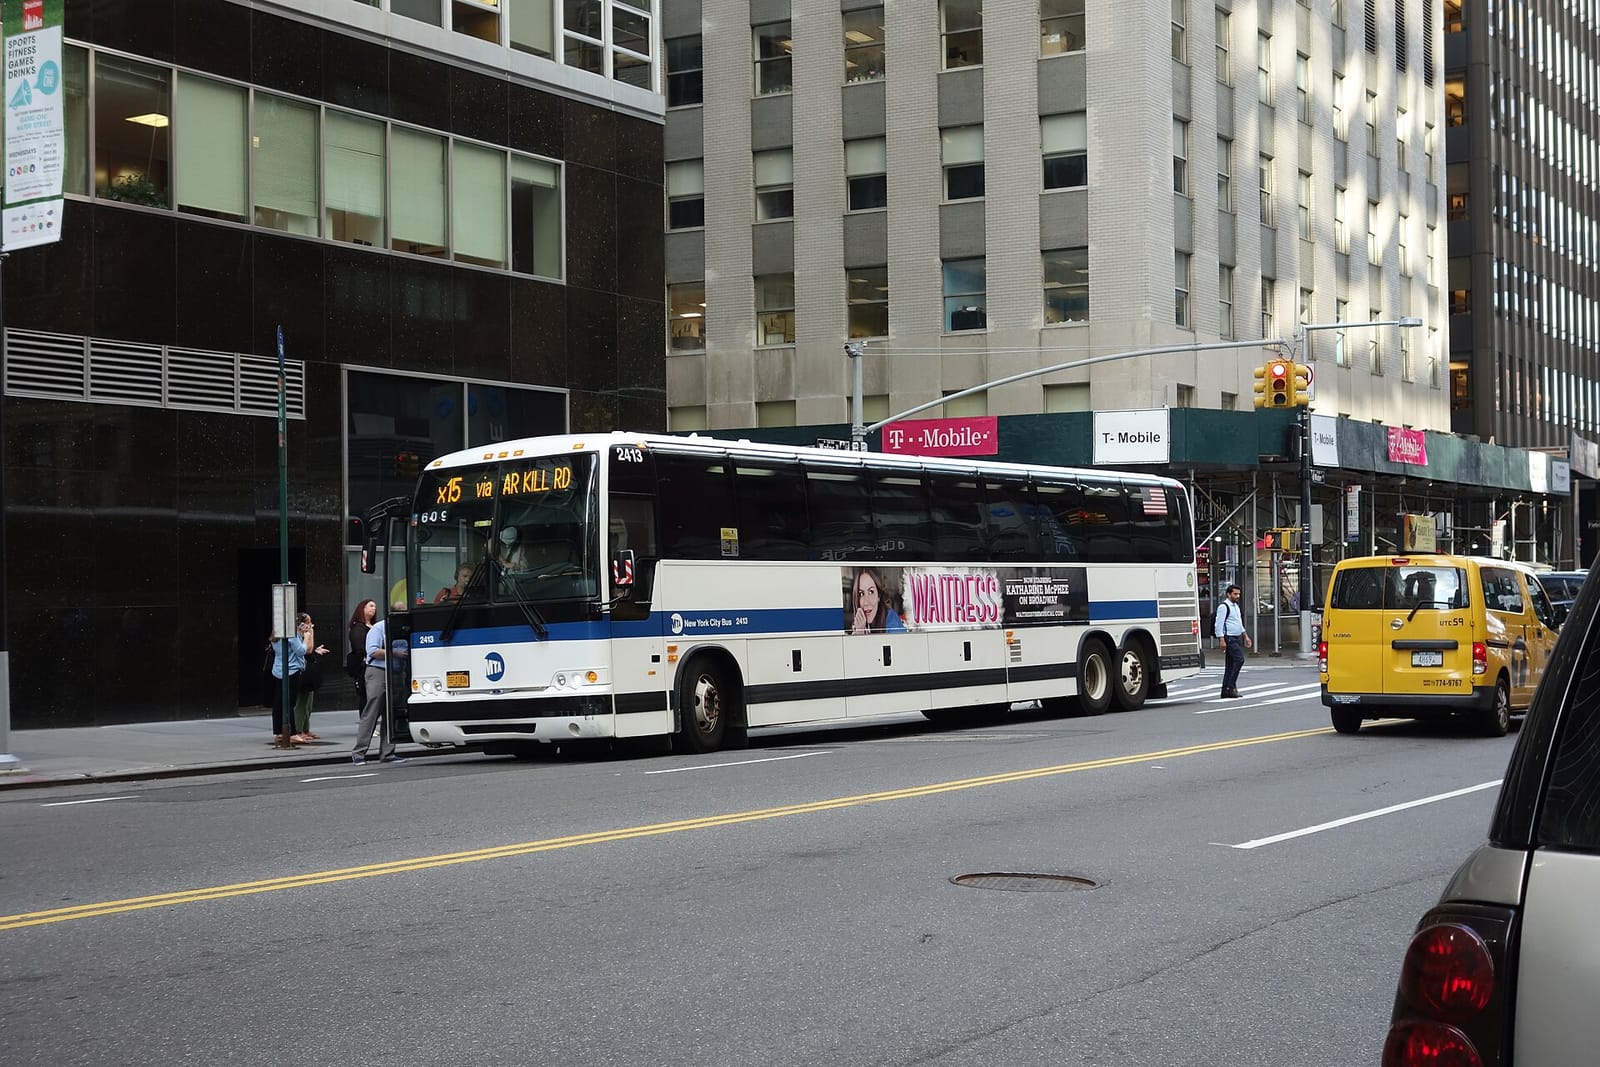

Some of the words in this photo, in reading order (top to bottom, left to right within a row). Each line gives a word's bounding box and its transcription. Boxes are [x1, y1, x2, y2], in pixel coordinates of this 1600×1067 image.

[8, 35, 36, 49] SPORTS
[8, 46, 37, 59] FITNESS
[8, 57, 34, 69] GAMES
[8, 66, 36, 80] DRINKS
[1118, 431, 1161, 444] Mobile
[616, 447, 643, 463] 2413
[436, 476, 463, 504] x15
[476, 475, 492, 498] via
[502, 472, 520, 496] AR
[522, 469, 550, 493] KILL
[553, 466, 571, 490] RD
[1006, 584, 1044, 595] KATHARINE
[1044, 584, 1069, 594] McPHEE
[908, 572, 999, 625] WAITRESS
[1019, 596, 1028, 605] ON
[1029, 595, 1058, 605] BROADWAY
[684, 619, 697, 627] New
[697, 619, 709, 627] York
[709, 618, 721, 627] City
[721, 617, 732, 626] Bus
[735, 617, 748, 625] 2413
[419, 635, 434, 644] 2413
[484, 658, 503, 676] MTA
